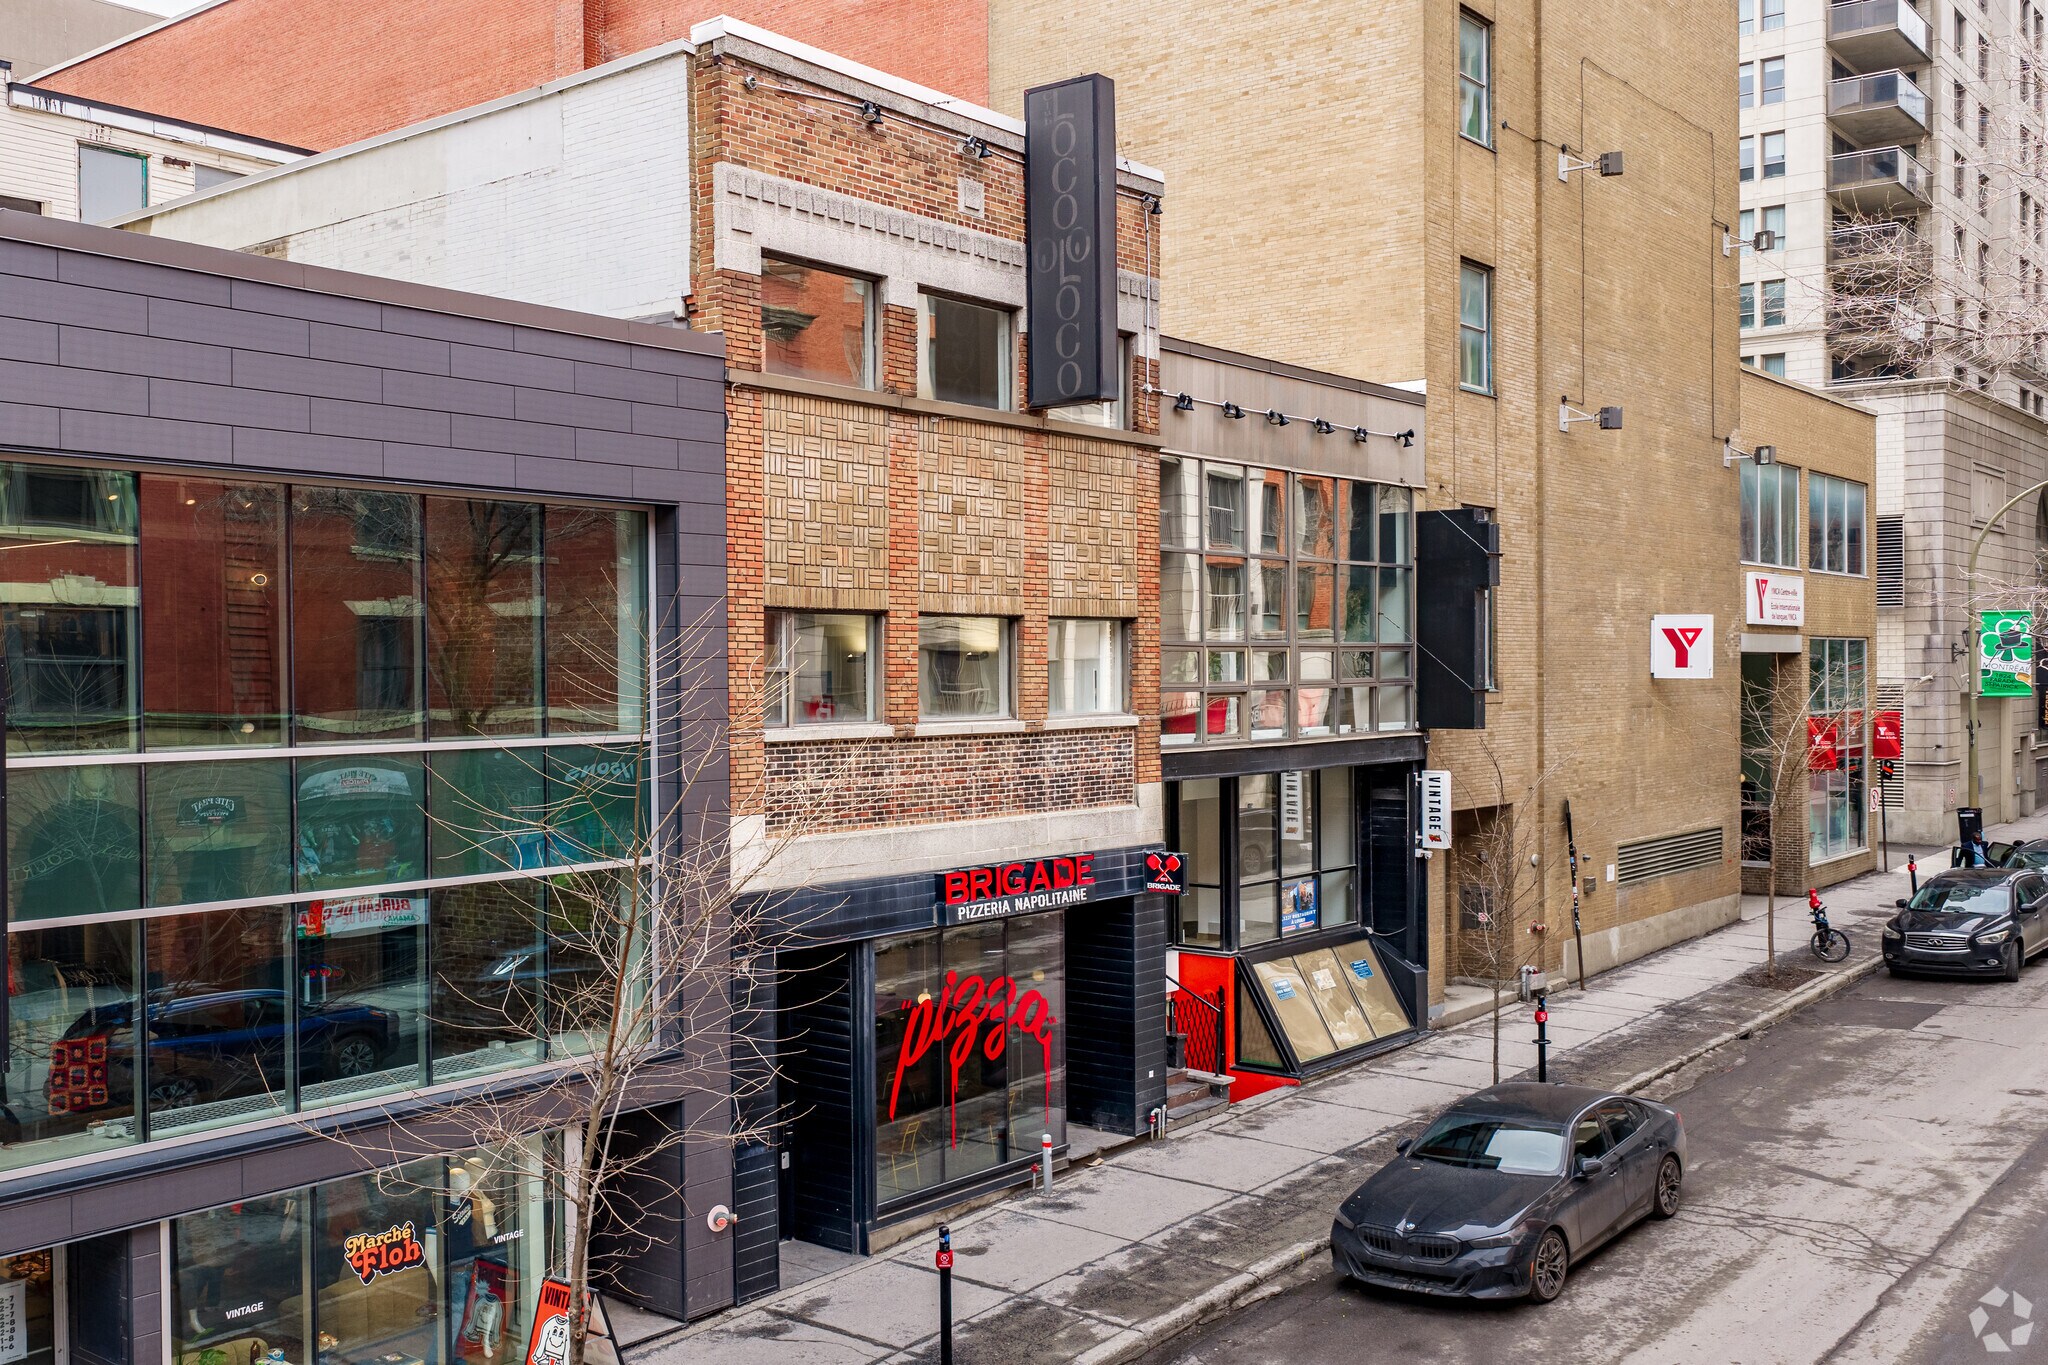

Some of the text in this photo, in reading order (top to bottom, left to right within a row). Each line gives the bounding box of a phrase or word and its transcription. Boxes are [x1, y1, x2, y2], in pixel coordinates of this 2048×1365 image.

[1428, 776, 1442, 830] VINTAGE
[945, 853, 1096, 905] BRIGADE
[1146, 882, 1182, 892] BRIGADE
[957, 888, 1088, 920] PIZZERIA NAPOLITAINE
[346, 1223, 412, 1259] Marché
[493, 1229, 524, 1244] VINTAGE
[351, 1238, 421, 1279] Floh
[226, 1301, 264, 1320] VINTAGE
